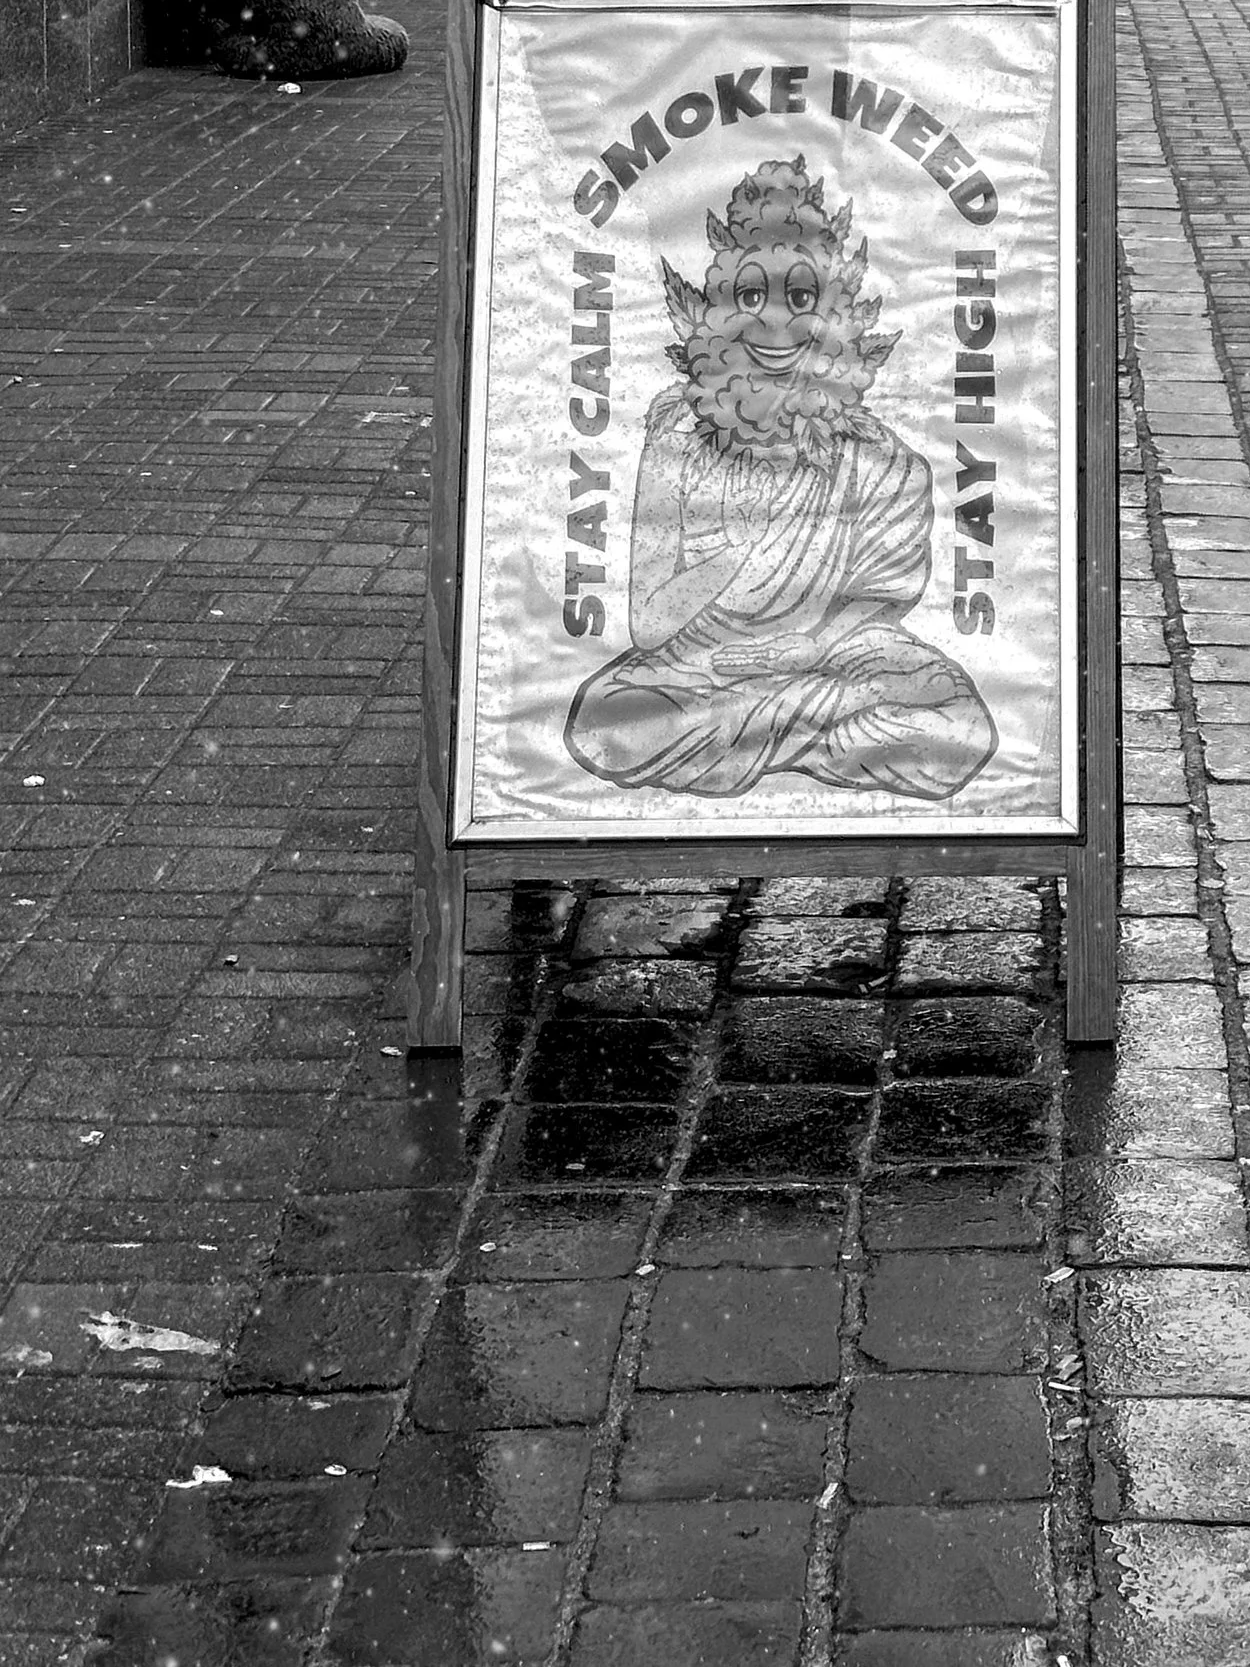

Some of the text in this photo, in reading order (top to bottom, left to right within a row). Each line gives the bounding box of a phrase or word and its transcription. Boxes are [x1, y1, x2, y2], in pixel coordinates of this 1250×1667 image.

[573, 65, 998, 230] SMOKE WEED
[564, 251, 616, 639] STAY CALM
[953, 249, 997, 637] STAY HIGH
